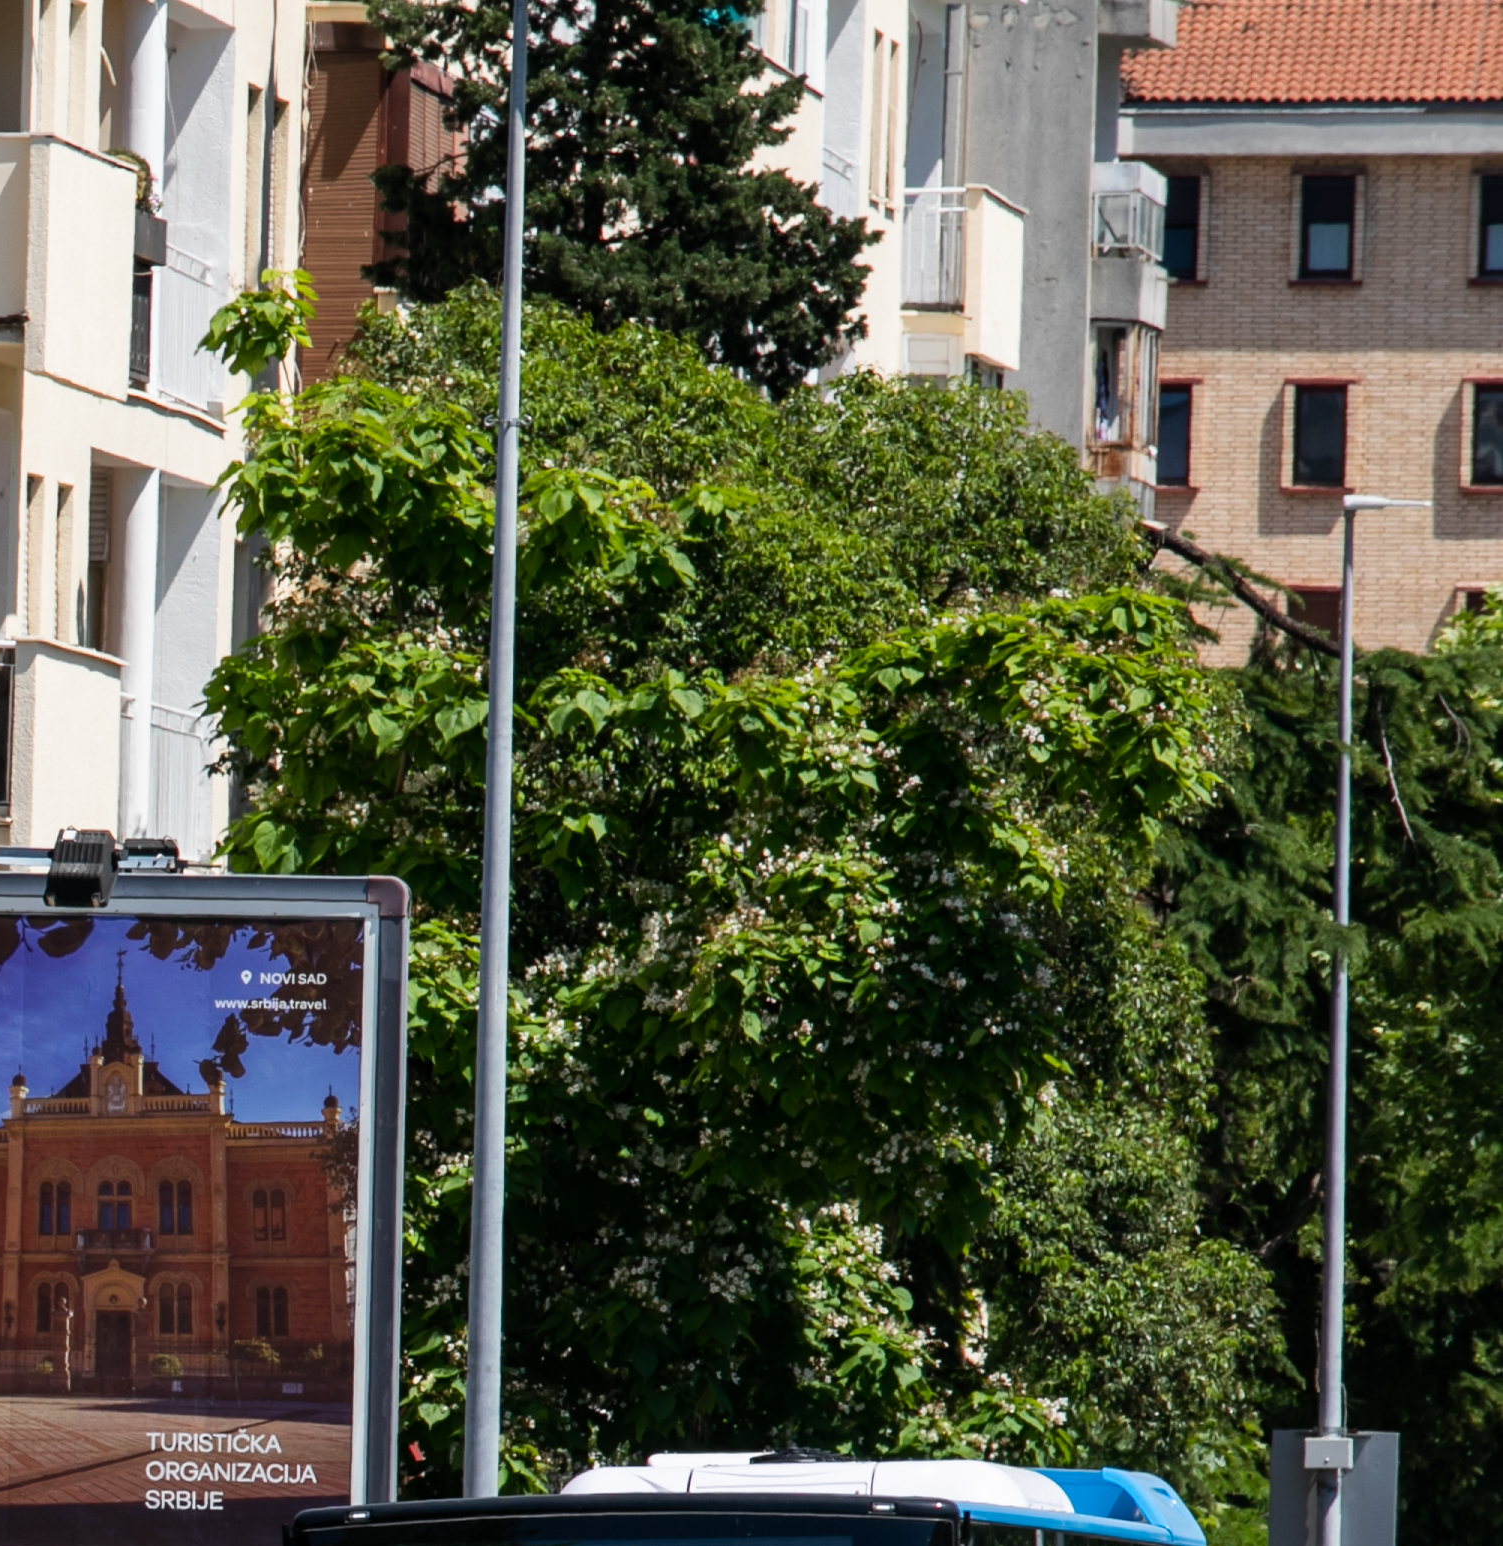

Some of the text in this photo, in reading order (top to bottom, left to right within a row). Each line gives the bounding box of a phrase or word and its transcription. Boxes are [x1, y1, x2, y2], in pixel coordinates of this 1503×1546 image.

[259, 972, 327, 985] NOVI SAD
[214, 998, 327, 1011] www.srbija.travel
[146, 1428, 282, 1454] TURISTIČKA
[145, 1460, 317, 1484] ORGANIZACIJA
[145, 1489, 224, 1511] SRBIJE
